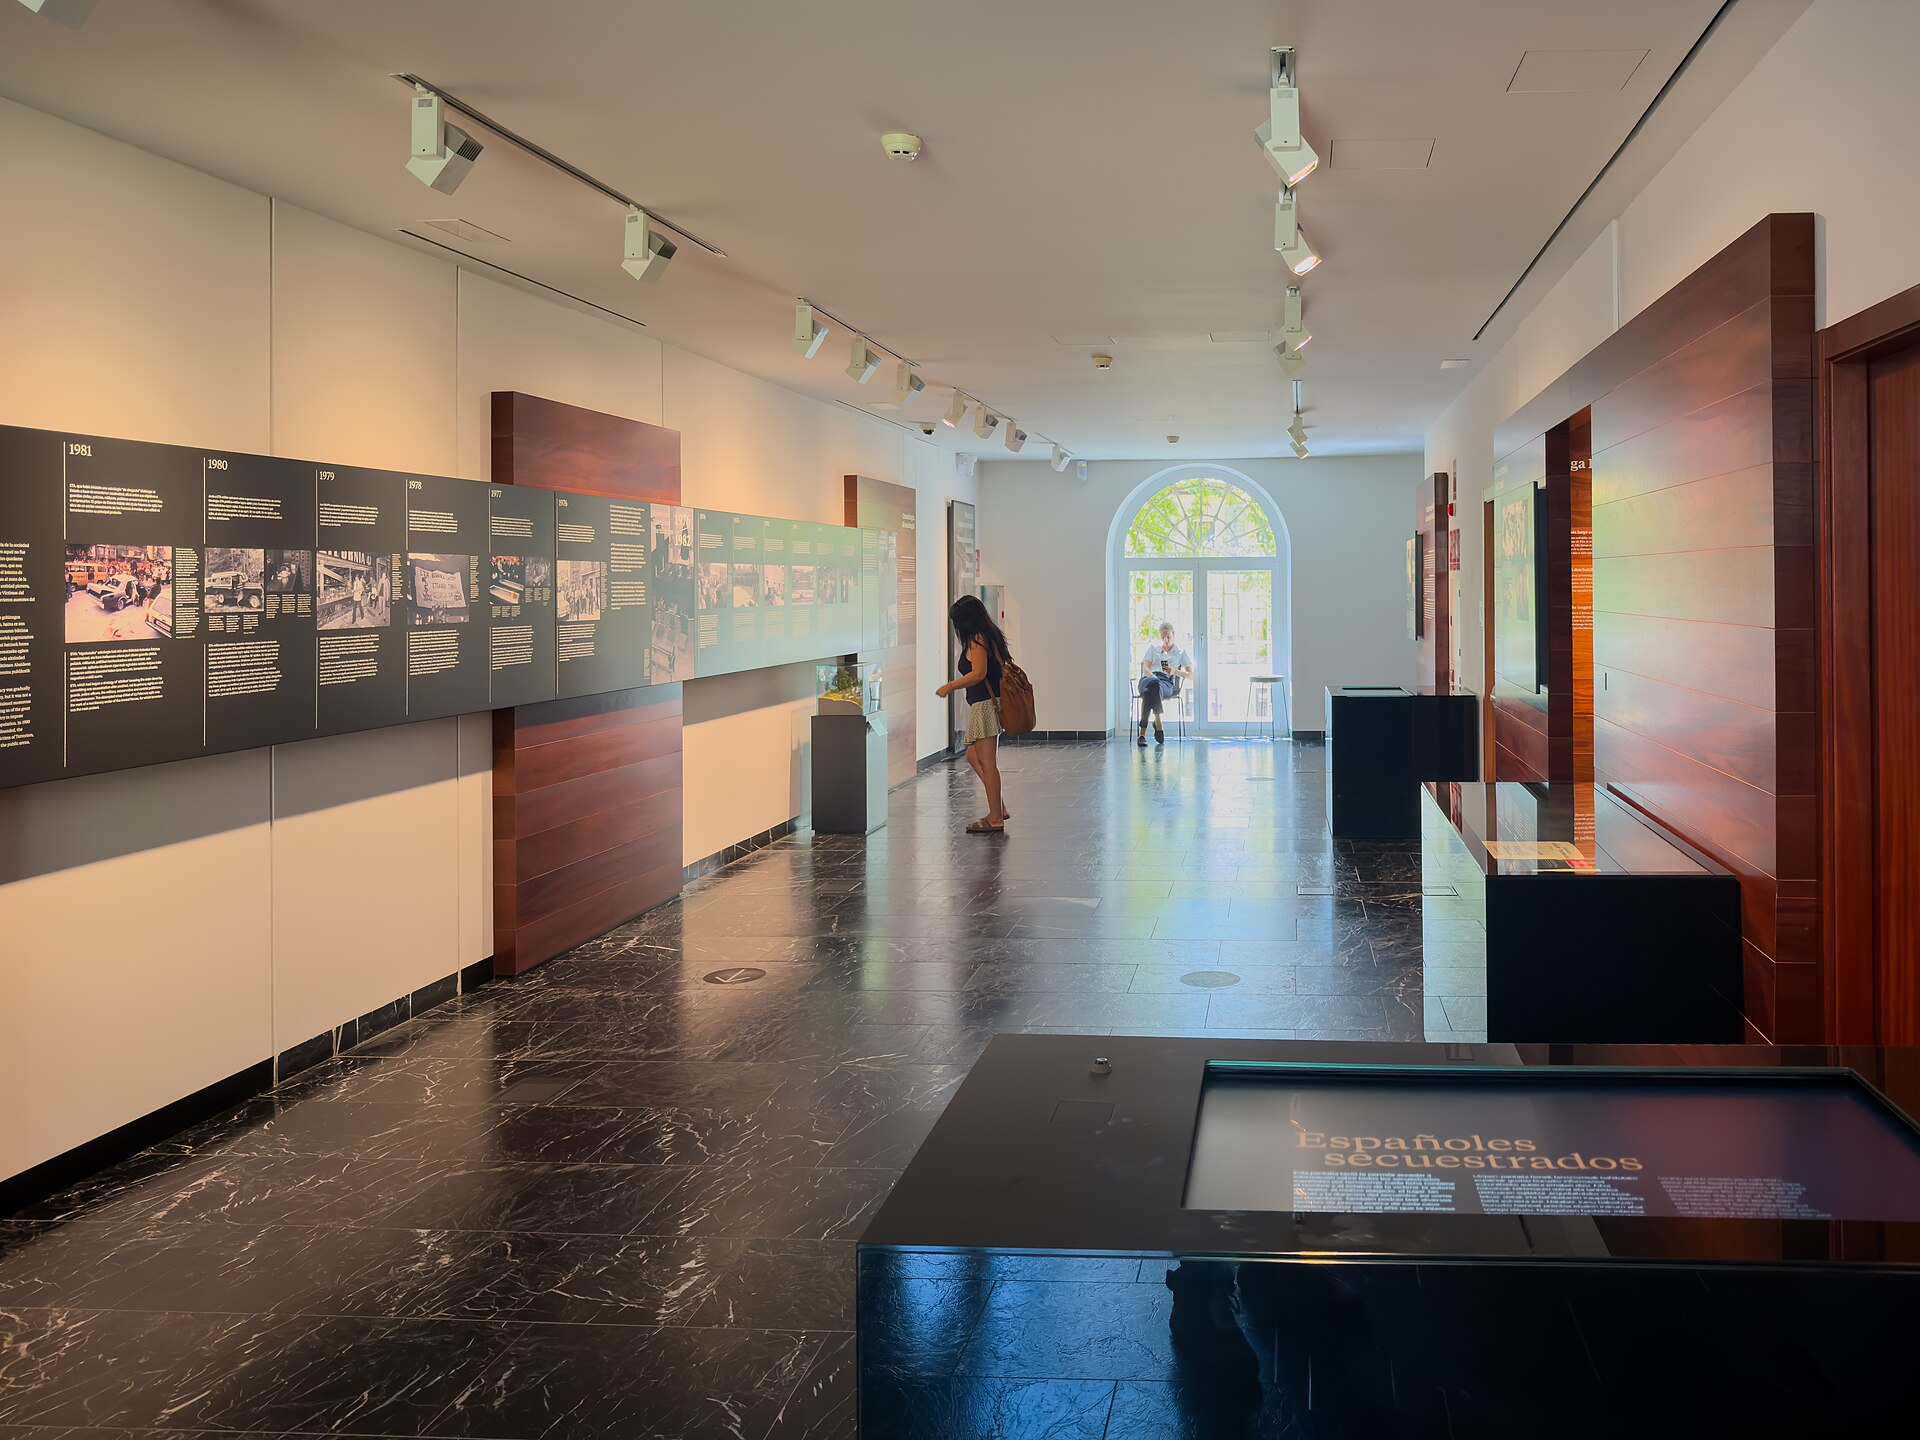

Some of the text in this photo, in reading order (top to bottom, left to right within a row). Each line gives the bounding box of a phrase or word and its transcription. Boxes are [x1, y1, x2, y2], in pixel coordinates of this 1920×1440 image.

[69, 443, 92, 457] 1981
[208, 458, 228, 471] 1980
[319, 470, 335, 481] 1979
[409, 480, 422, 490] 1978
[491, 489, 502, 498] 1977
[558, 498, 569, 507] 1976
[674, 534, 692, 547] 1982
[1296, 1131, 1537, 1153] Españoles
[1324, 1152, 1644, 1171] secuestrados
